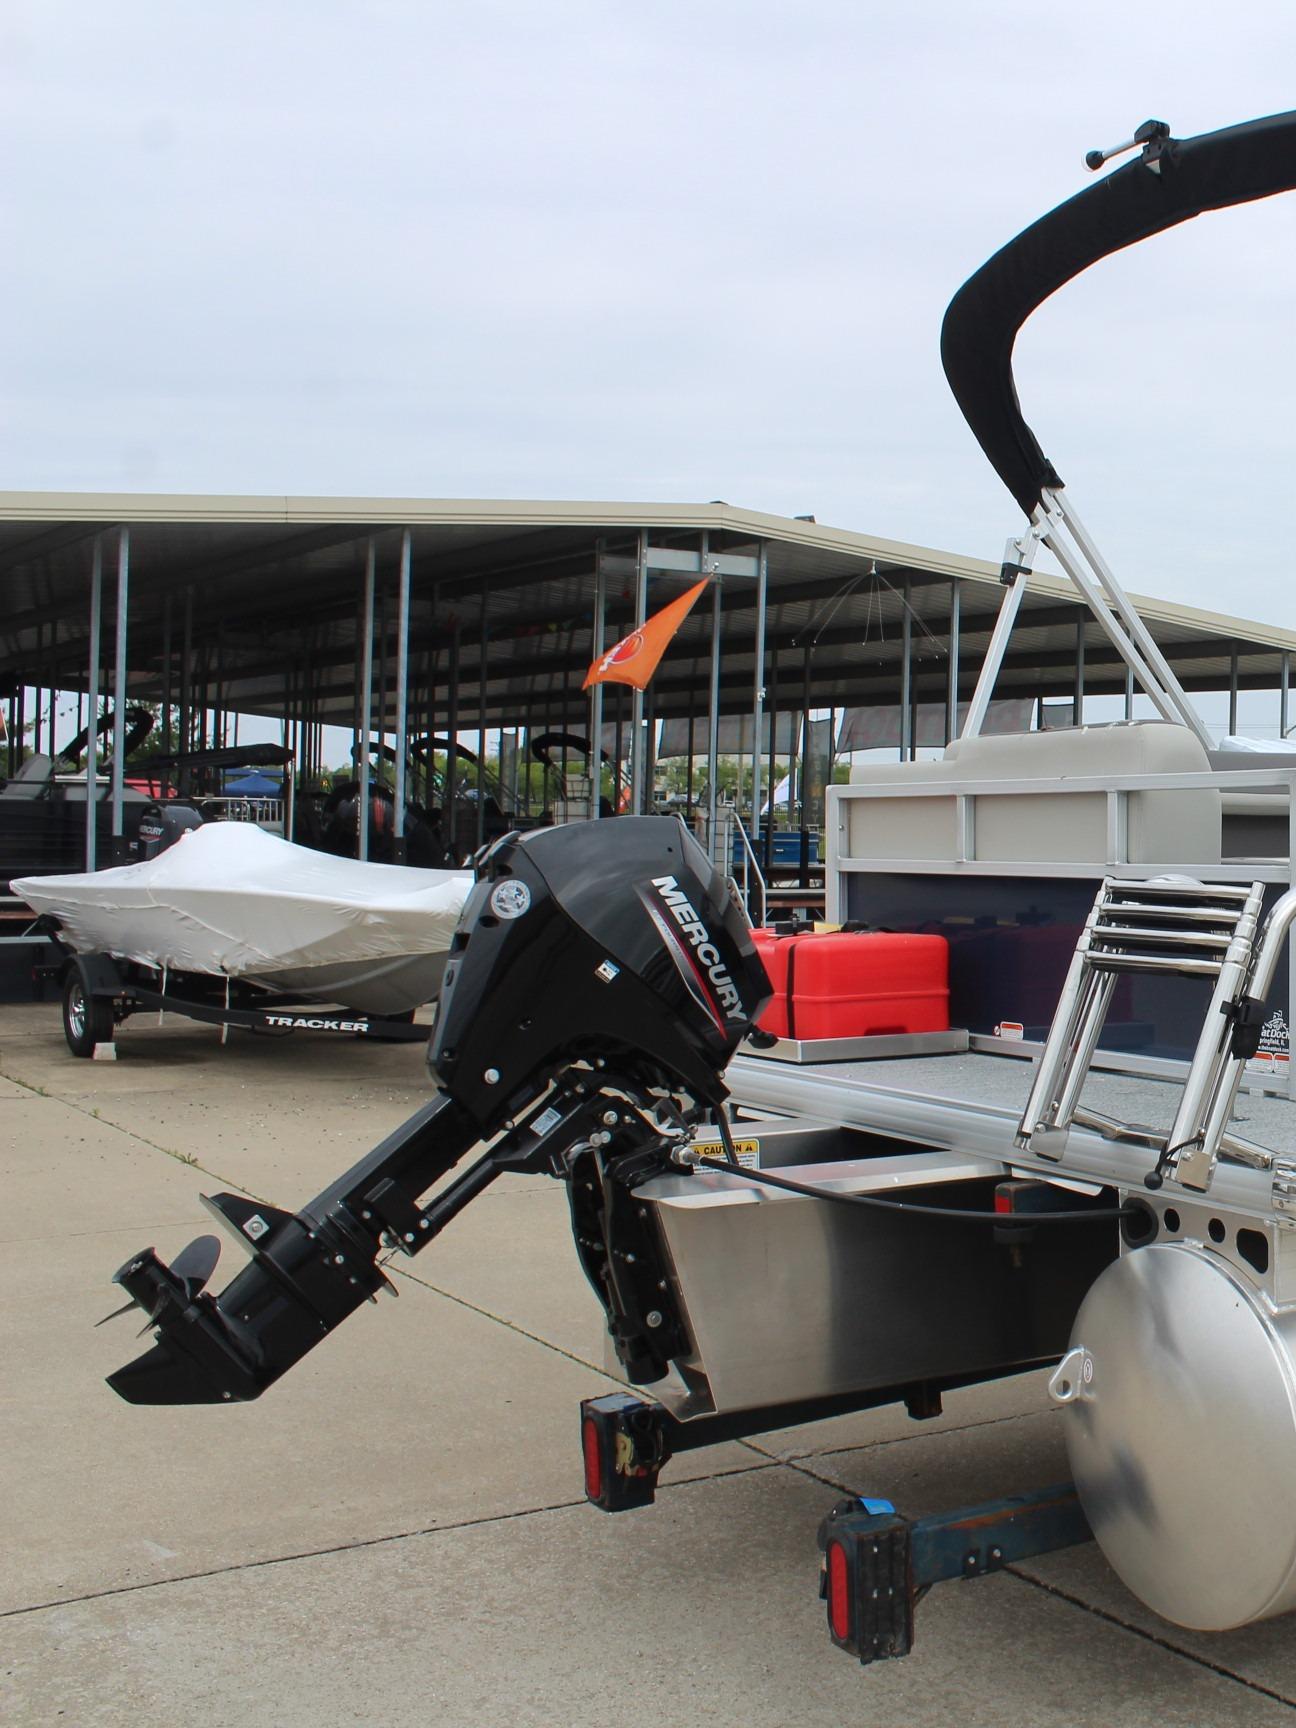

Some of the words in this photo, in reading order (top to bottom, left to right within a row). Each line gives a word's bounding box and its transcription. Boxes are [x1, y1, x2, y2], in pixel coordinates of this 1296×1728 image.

[651, 875, 749, 1021] MERCURY
[265, 1015, 369, 1032] TRACKER
[703, 1143, 742, 1155] CAUTN
